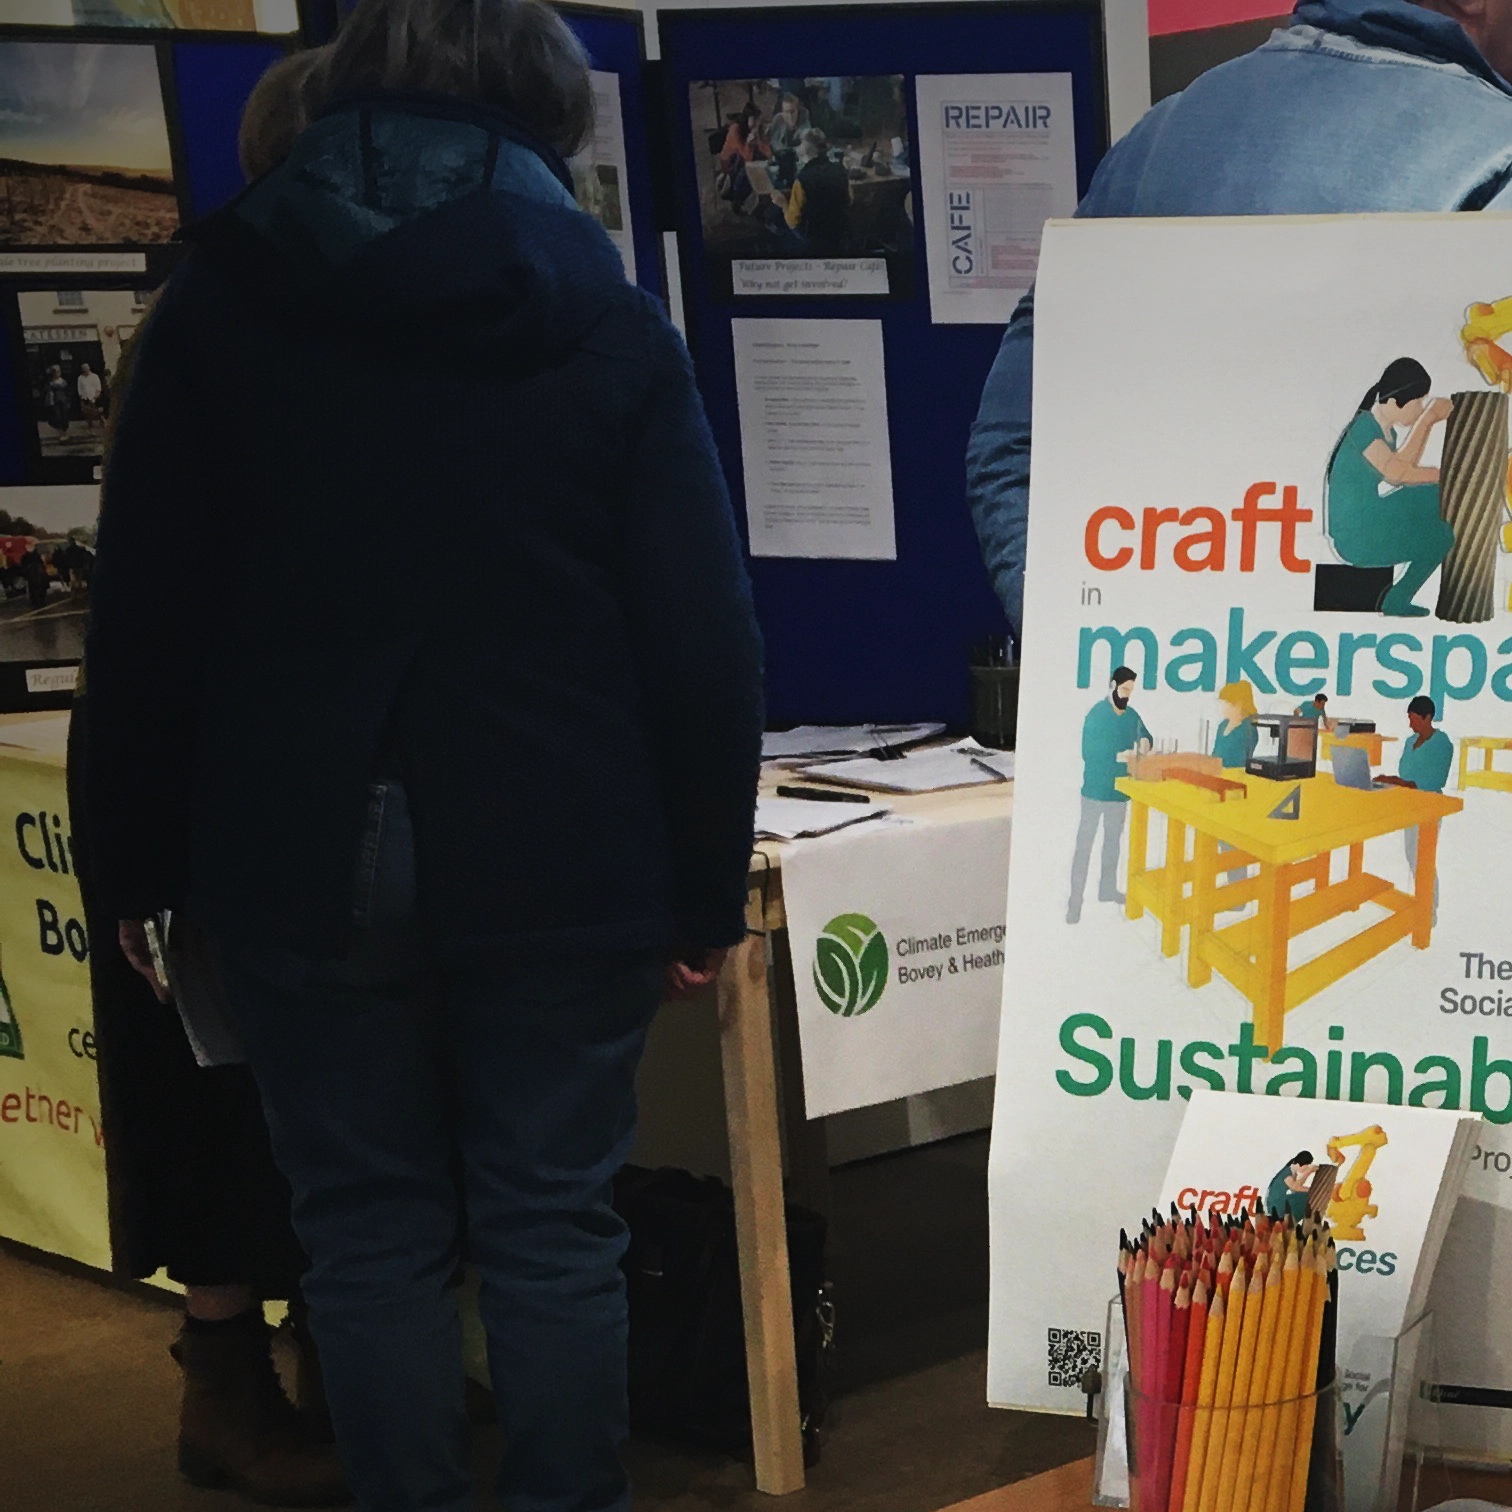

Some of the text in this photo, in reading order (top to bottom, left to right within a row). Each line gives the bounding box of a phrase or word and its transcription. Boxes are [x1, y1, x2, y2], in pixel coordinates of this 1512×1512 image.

[944, 105, 1051, 129] REPAIR
[949, 191, 973, 275] CAFE
[1084, 481, 1312, 574] craft
[1081, 581, 1102, 606] in
[896, 933, 953, 957] Climate
[898, 964, 944, 984] Bovey
[947, 956, 959, 975] &
[1177, 1185, 1260, 1217] craft
